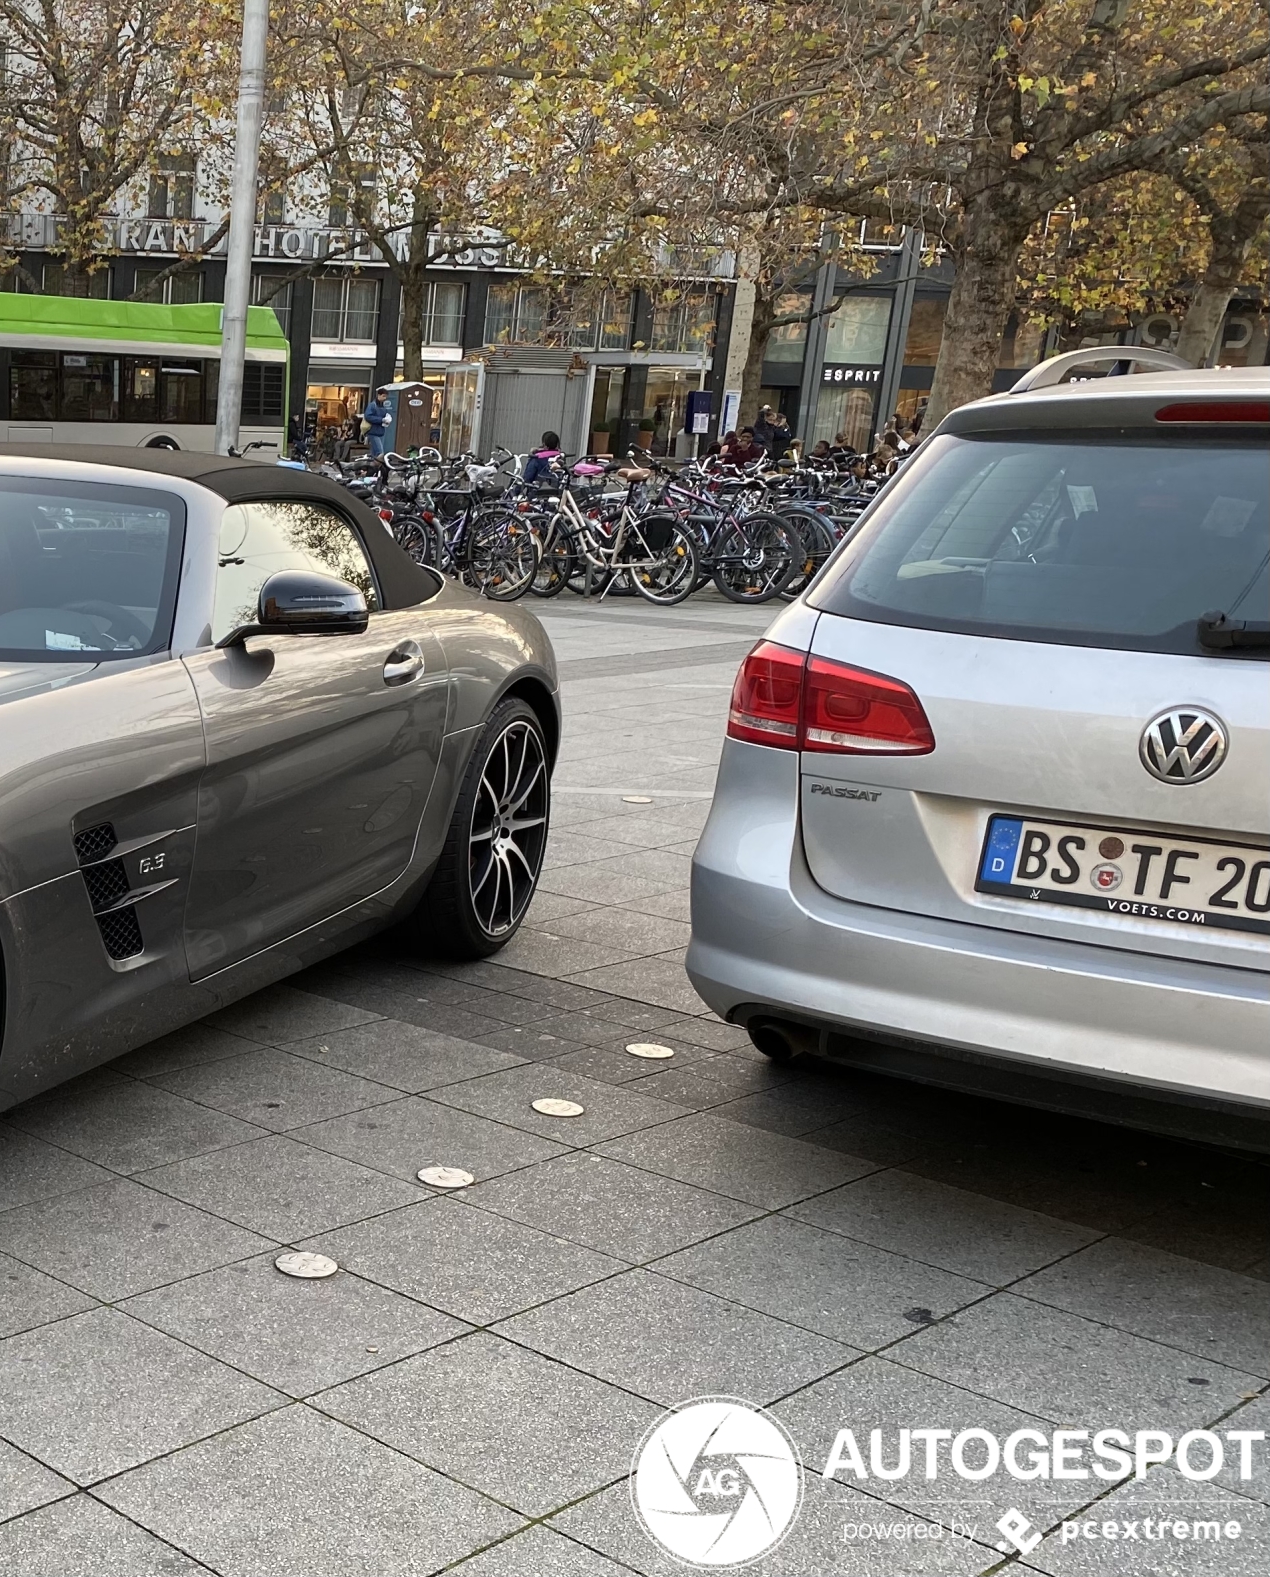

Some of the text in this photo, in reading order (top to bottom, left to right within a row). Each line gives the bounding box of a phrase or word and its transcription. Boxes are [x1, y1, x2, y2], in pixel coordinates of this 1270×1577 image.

[253, 224, 371, 262] HOTEL
[824, 369, 881, 382] ESPRIT
[811, 783, 882, 802] PASSAT
[991, 858, 1005, 872] D
[1017, 829, 1086, 884] BS
[1131, 844, 1200, 899] TF
[1107, 899, 1205, 924] VOETS.COM
